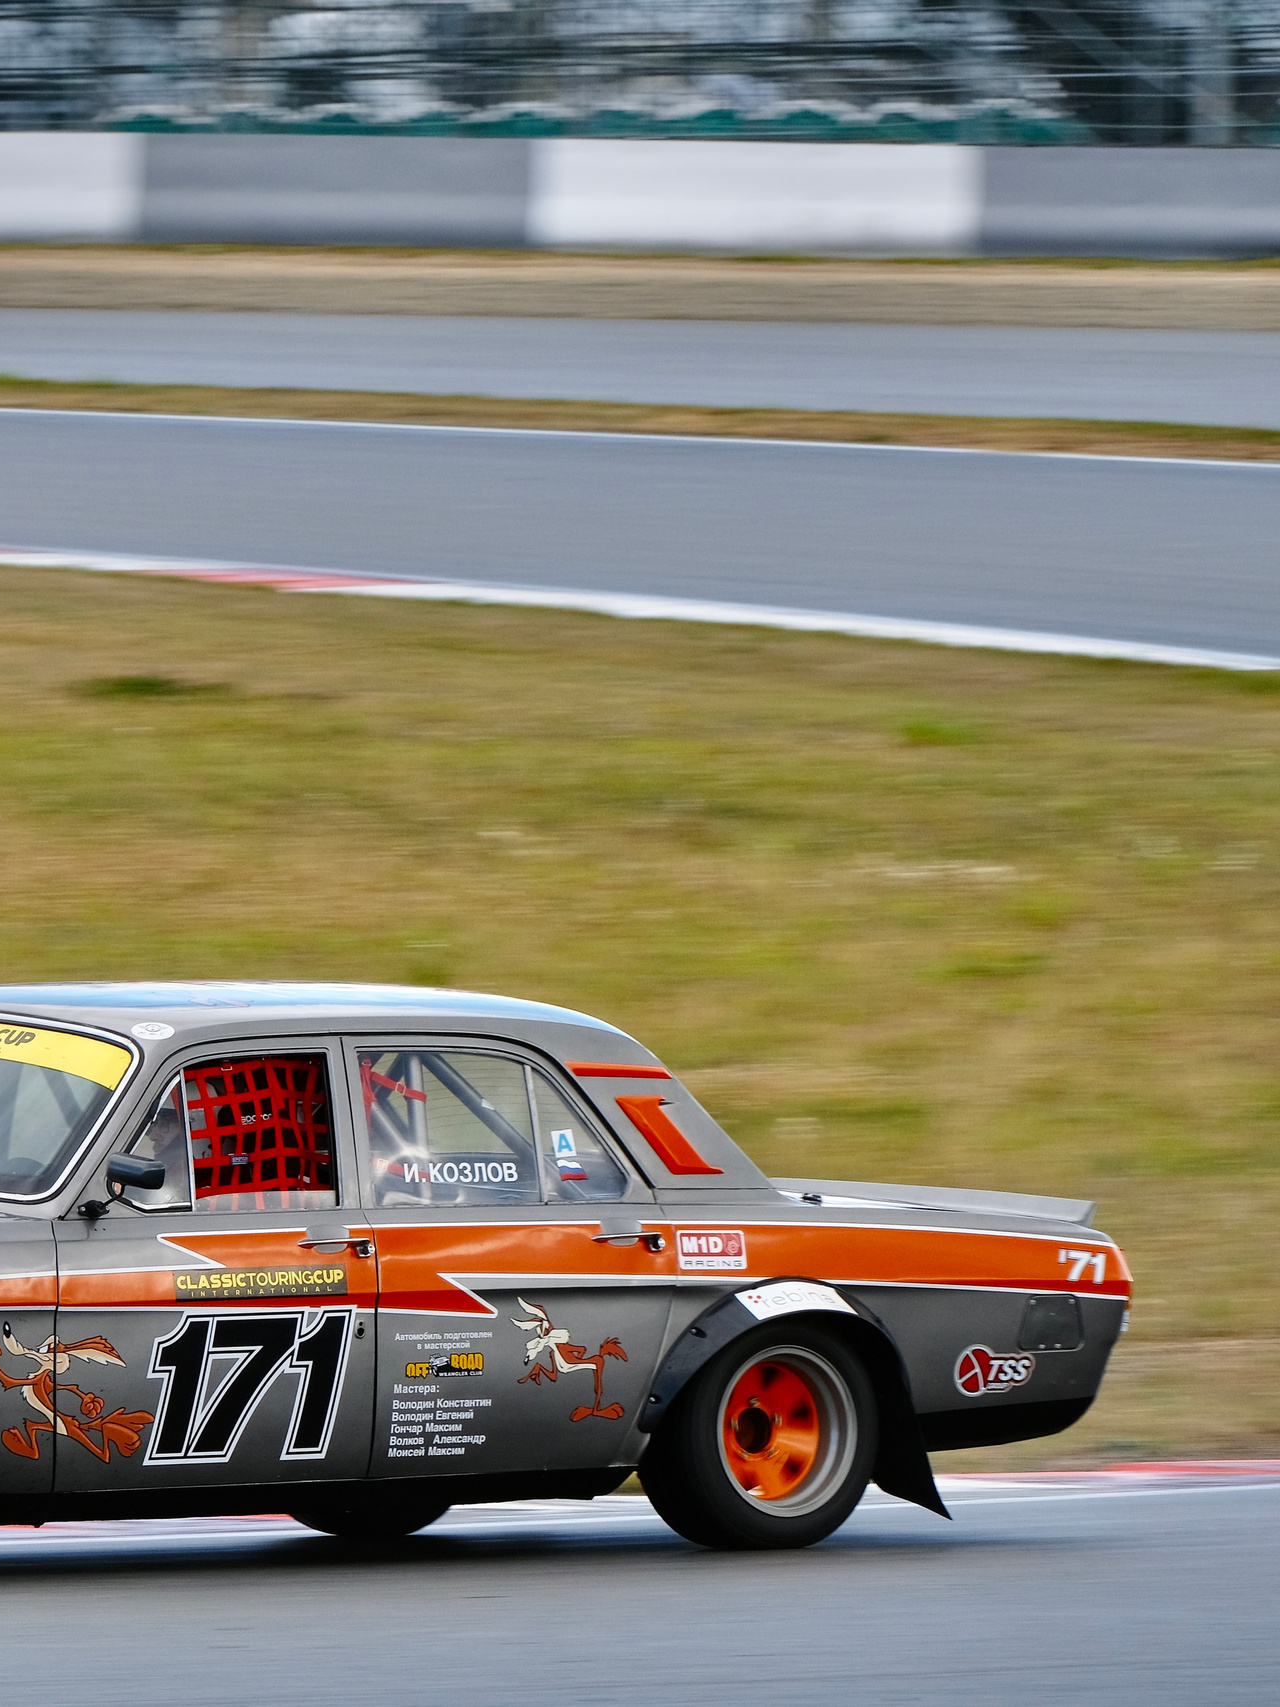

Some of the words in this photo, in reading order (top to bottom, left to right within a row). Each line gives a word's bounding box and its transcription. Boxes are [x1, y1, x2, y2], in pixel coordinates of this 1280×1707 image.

[684, 1260, 742, 1268] RACING
[176, 1269, 344, 1290] CLASSICTOURINGCUP
[190, 1285, 333, 1298] INTERNATIONAL
[394, 1331, 442, 1341] Автомобиль
[443, 1331, 493, 1341] подготовлен
[424, 1340, 471, 1351] мастерской
[405, 1362, 430, 1378] OFF
[450, 1352, 484, 1370] ROAD
[987, 1359, 1031, 1381] TSS
[142, 1304, 357, 1466] 171
[393, 1384, 440, 1395] Мастера:
[392, 1400, 434, 1411] Володин
[436, 1398, 492, 1408] Константин
[391, 1411, 434, 1422] Володин
[435, 1409, 474, 1420] Евгений
[390, 1423, 423, 1435] Гончар
[425, 1422, 462, 1433] Максим
[389, 1436, 424, 1446] Волков
[432, 1434, 486, 1445] Александр
[387, 1447, 425, 1458] Моисей
[427, 1446, 465, 1457] Максим
